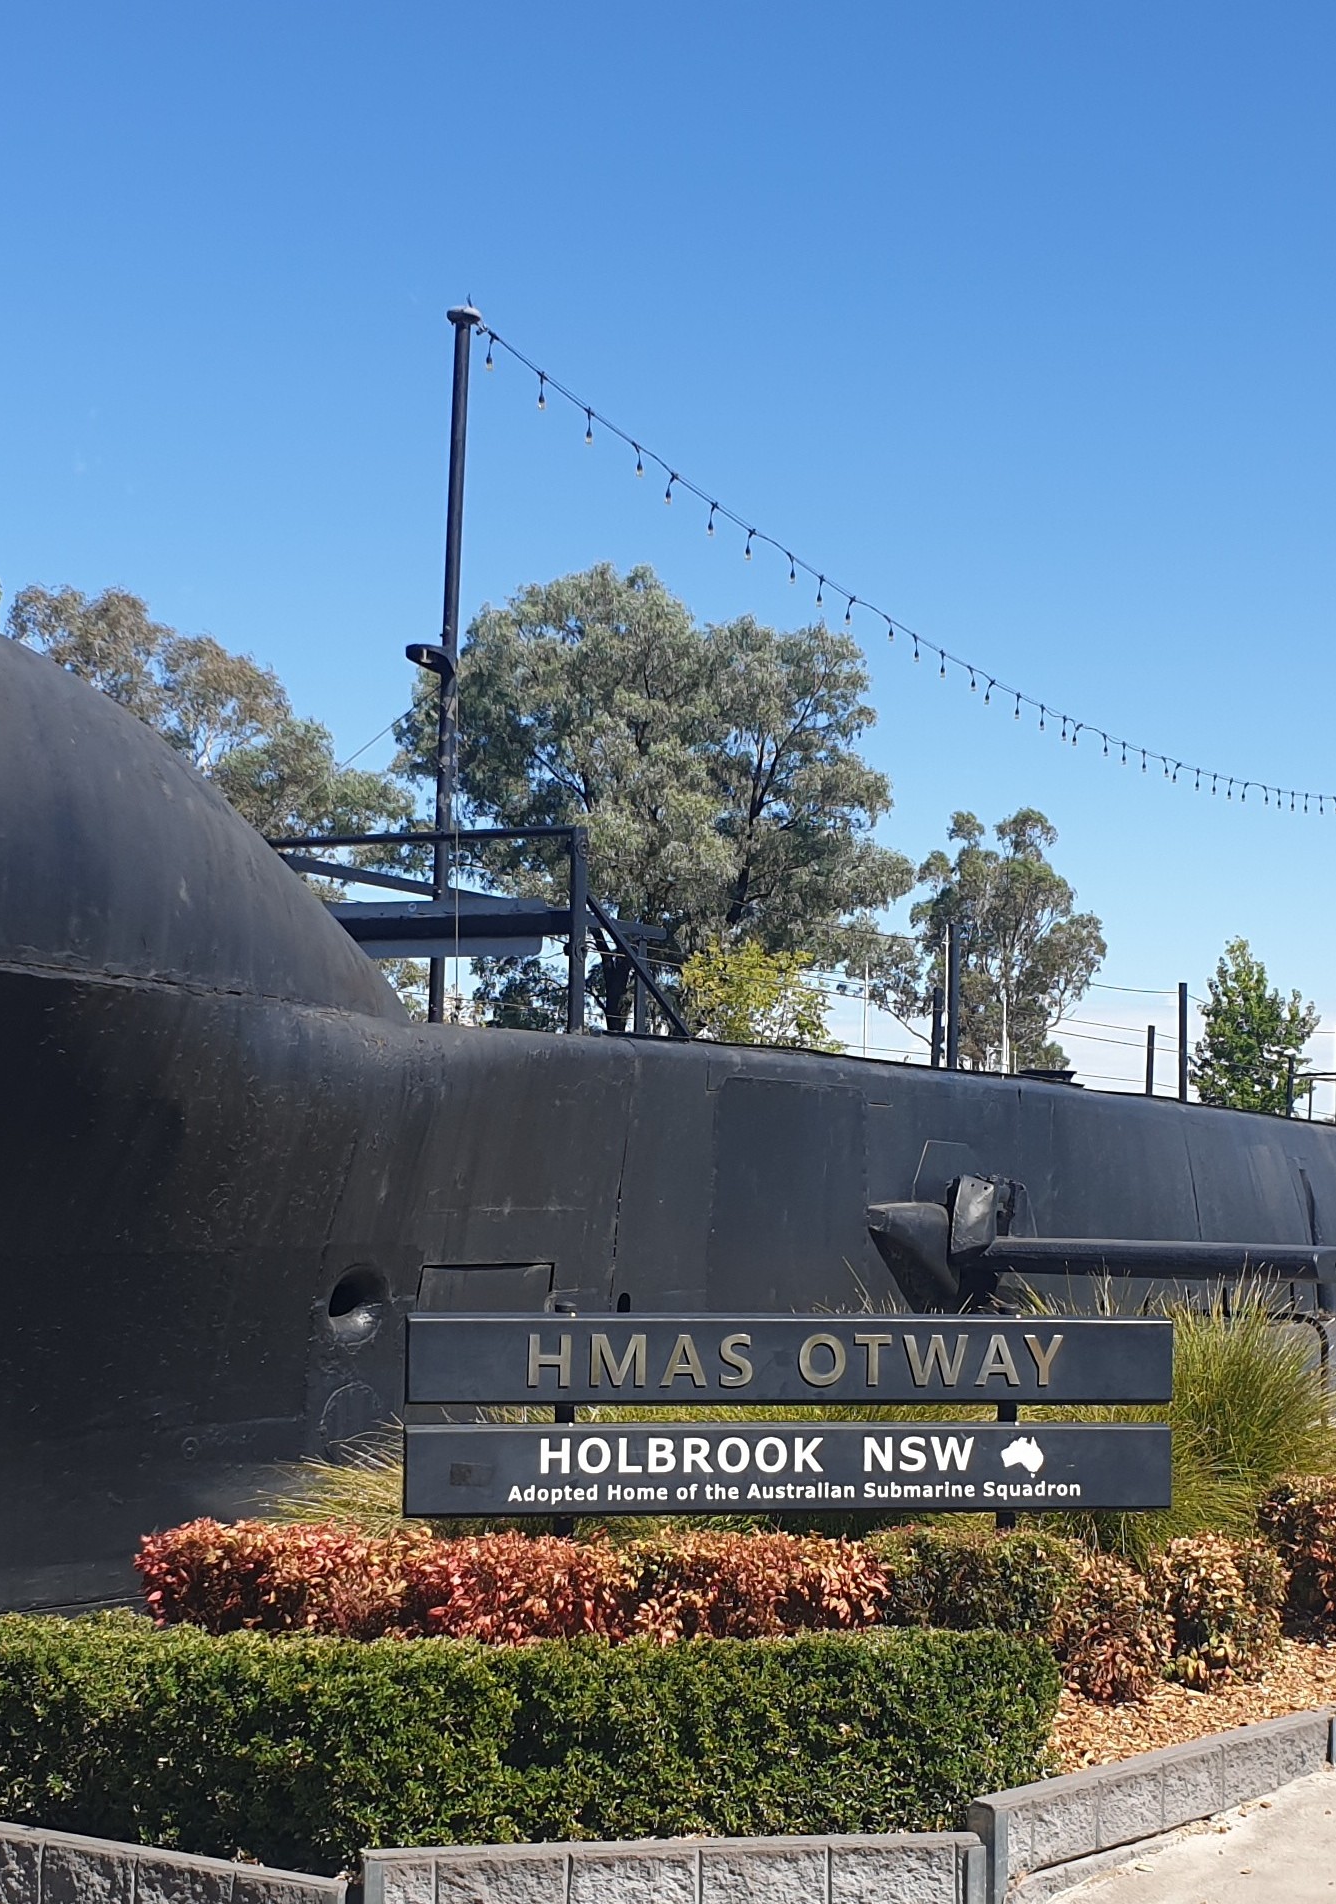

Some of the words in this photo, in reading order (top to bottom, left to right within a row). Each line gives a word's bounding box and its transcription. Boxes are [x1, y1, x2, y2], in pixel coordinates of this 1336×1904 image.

[526, 1333, 753, 1388] HMAS
[798, 1333, 1064, 1388] OTWAY
[539, 1436, 824, 1474] HOLBROOK
[863, 1435, 975, 1472] NSW
[507, 1484, 598, 1506] Adopted
[607, 1484, 669, 1501] Home
[676, 1483, 699, 1501] of
[704, 1483, 740, 1500] the
[746, 1481, 856, 1500] Australian
[863, 1481, 976, 1499] Submarine
[982, 1480, 1081, 1501] Squadron
